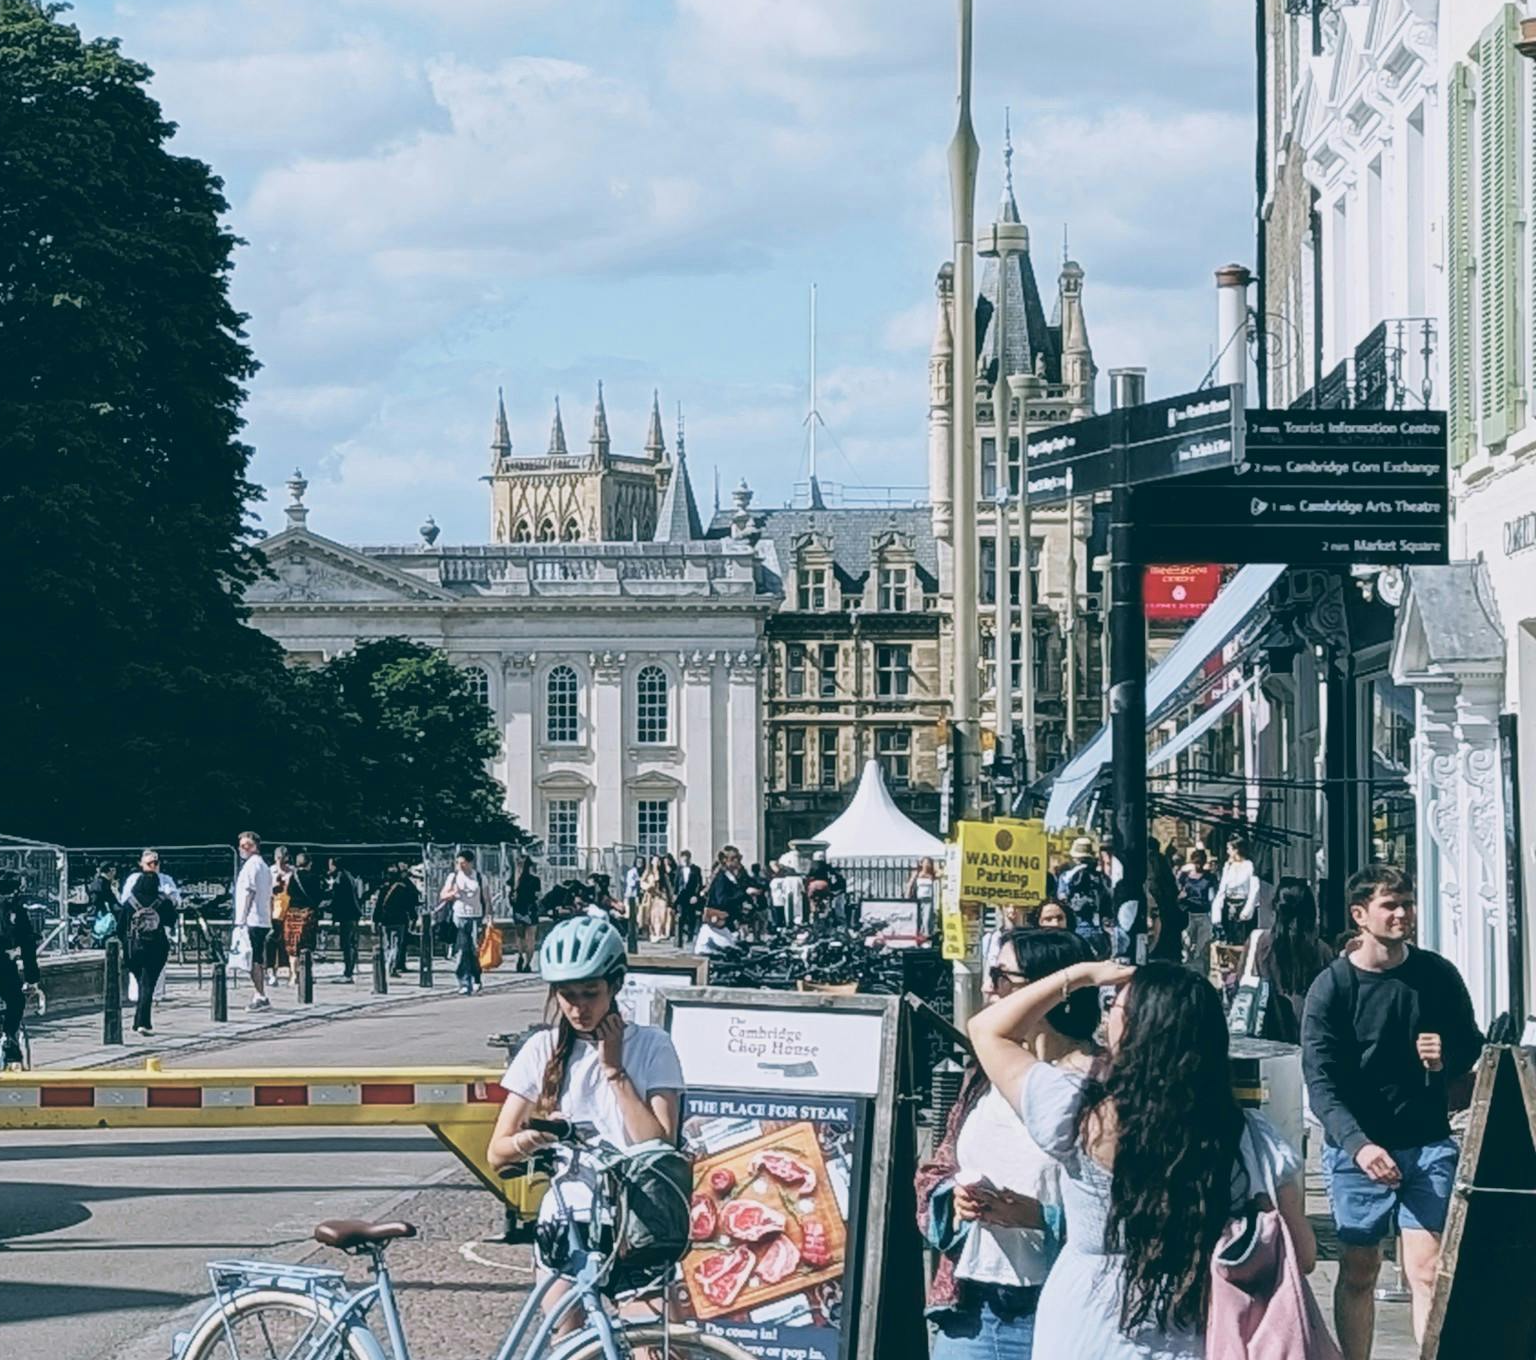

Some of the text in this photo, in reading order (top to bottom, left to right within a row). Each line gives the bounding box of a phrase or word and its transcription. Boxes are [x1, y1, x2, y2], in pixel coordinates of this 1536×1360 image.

[1283, 422, 1324, 434] Tourist
[1328, 422, 1397, 434] Information
[1400, 422, 1440, 434] Centre
[1286, 461, 1349, 475] Cambridge
[1352, 462, 1380, 473] Corn
[1383, 461, 1440, 476] Exchange
[1299, 500, 1363, 515] Cambridge
[1366, 500, 1392, 513] Arts
[1395, 500, 1440, 513] Theatre
[1322, 542, 1328, 551] 2
[1354, 540, 1396, 551] Market
[1399, 540, 1440, 553] Square
[966, 851, 1040, 870] WARNING
[977, 868, 1029, 888] Parking
[964, 885, 1040, 900] suspension
[730, 1016, 746, 1024] The
[728, 1025, 802, 1044] Cambridge
[727, 1039, 819, 1057] Chop House
[689, 1100, 848, 1121] THE PLACE FOR STEAK
[705, 1322, 777, 1340] Do come in!
[766, 1347, 781, 1357] or
